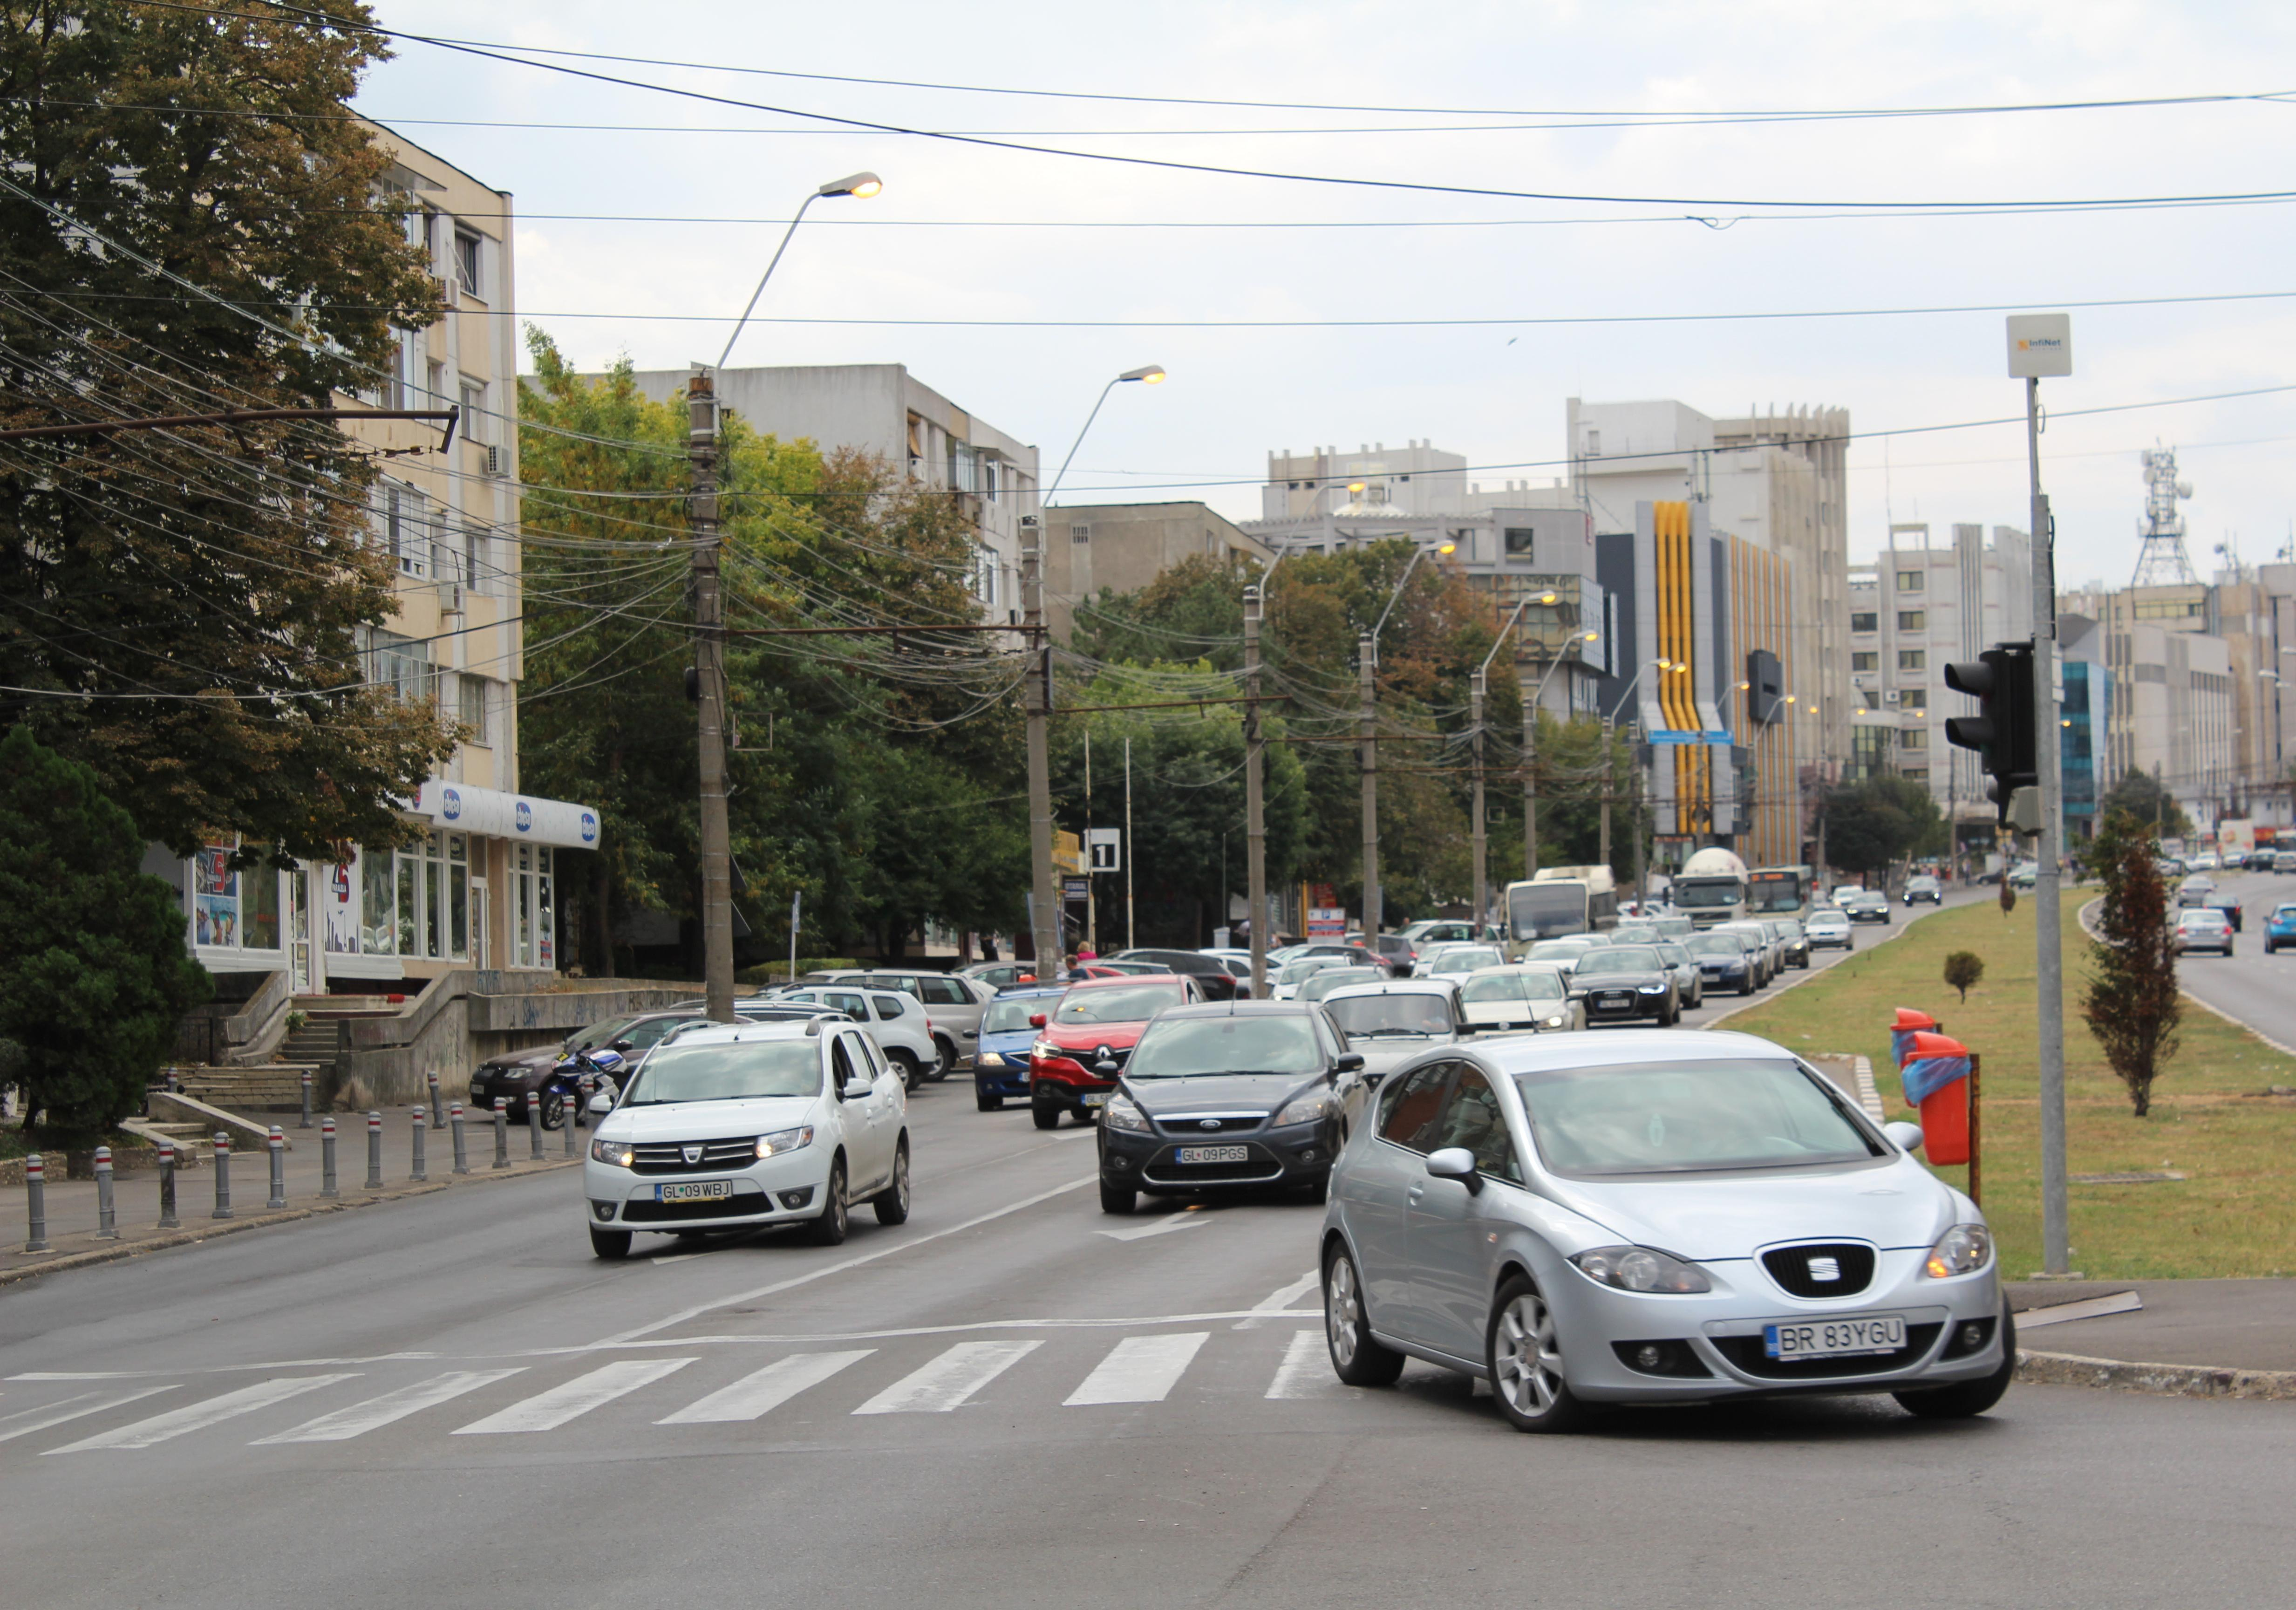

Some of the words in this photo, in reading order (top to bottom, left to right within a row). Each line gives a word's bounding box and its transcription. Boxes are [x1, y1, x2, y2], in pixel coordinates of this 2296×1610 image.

[1096, 845, 1106, 866] 1
[1183, 1150, 1198, 1161] GL
[663, 1186, 680, 1198] GL
[1781, 1327, 1815, 1351] BR
